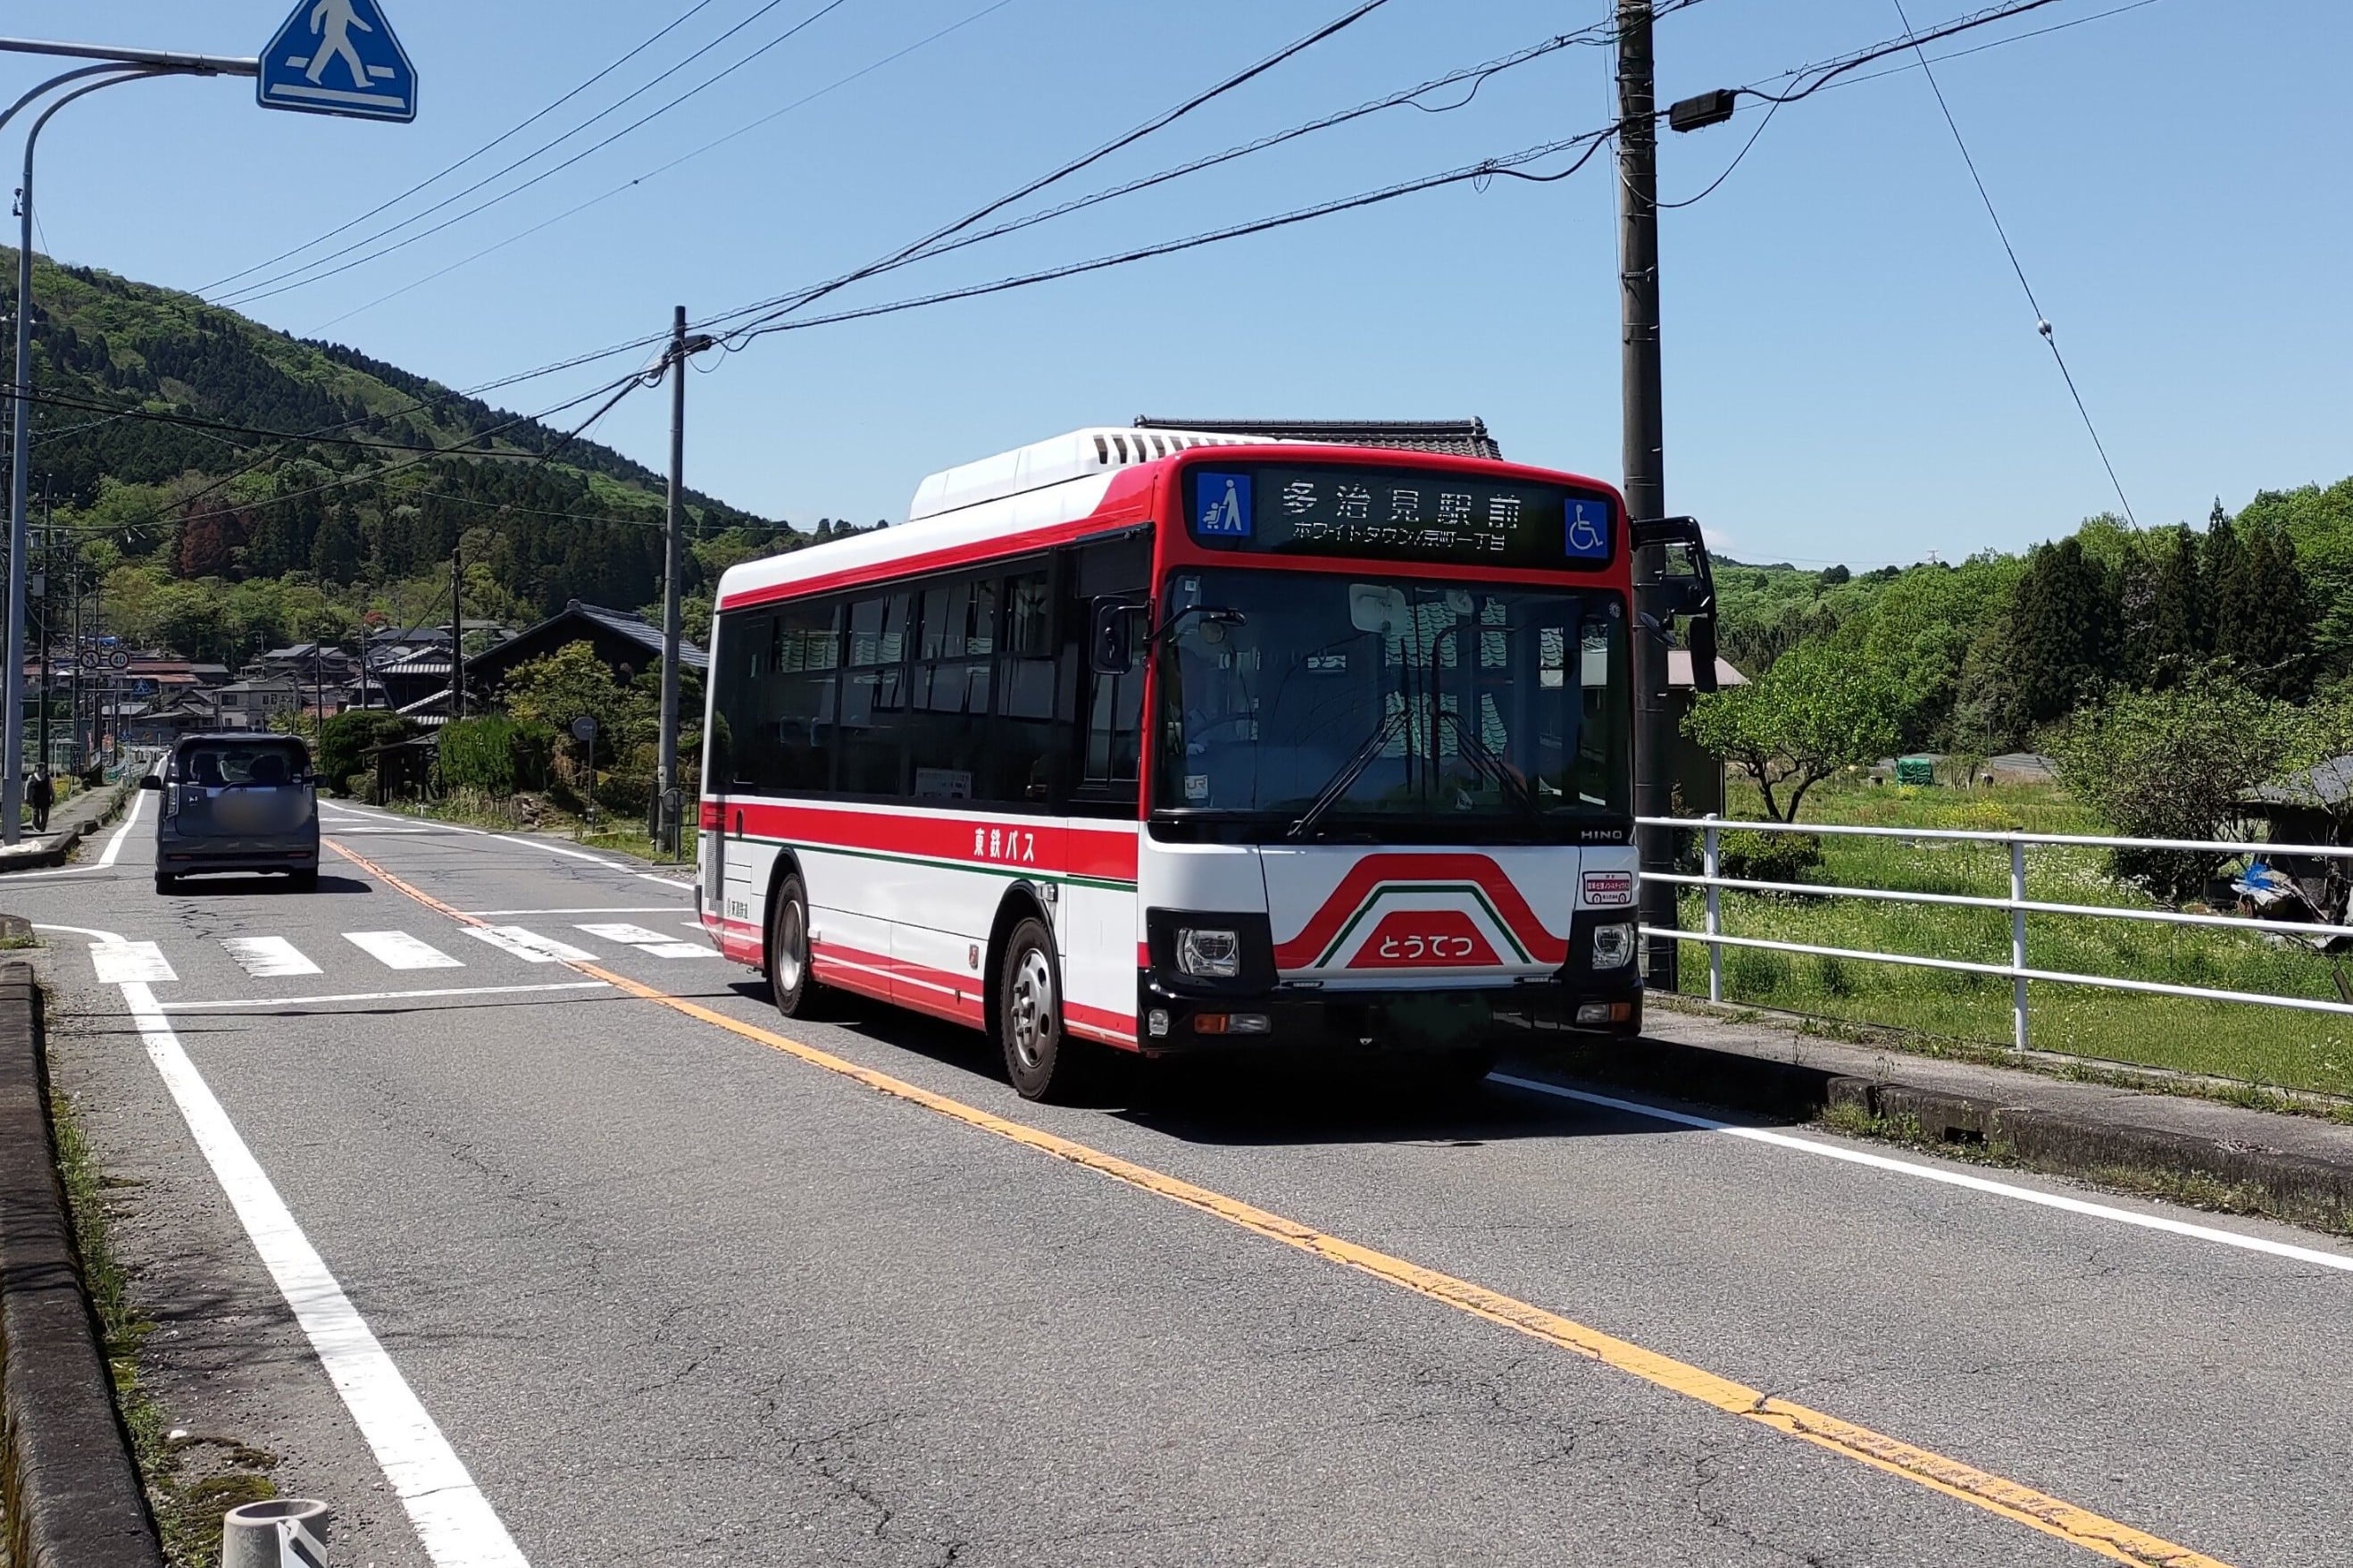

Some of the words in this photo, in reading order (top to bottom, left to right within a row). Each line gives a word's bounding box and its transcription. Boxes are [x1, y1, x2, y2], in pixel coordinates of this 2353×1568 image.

[1282, 480, 1522, 530] 多治見駅前
[113, 655, 125, 664] 40
[973, 827, 1035, 863] 東鉄バス
[1581, 830, 1623, 839] HINO
[1379, 935, 1473, 958] とうてつ
